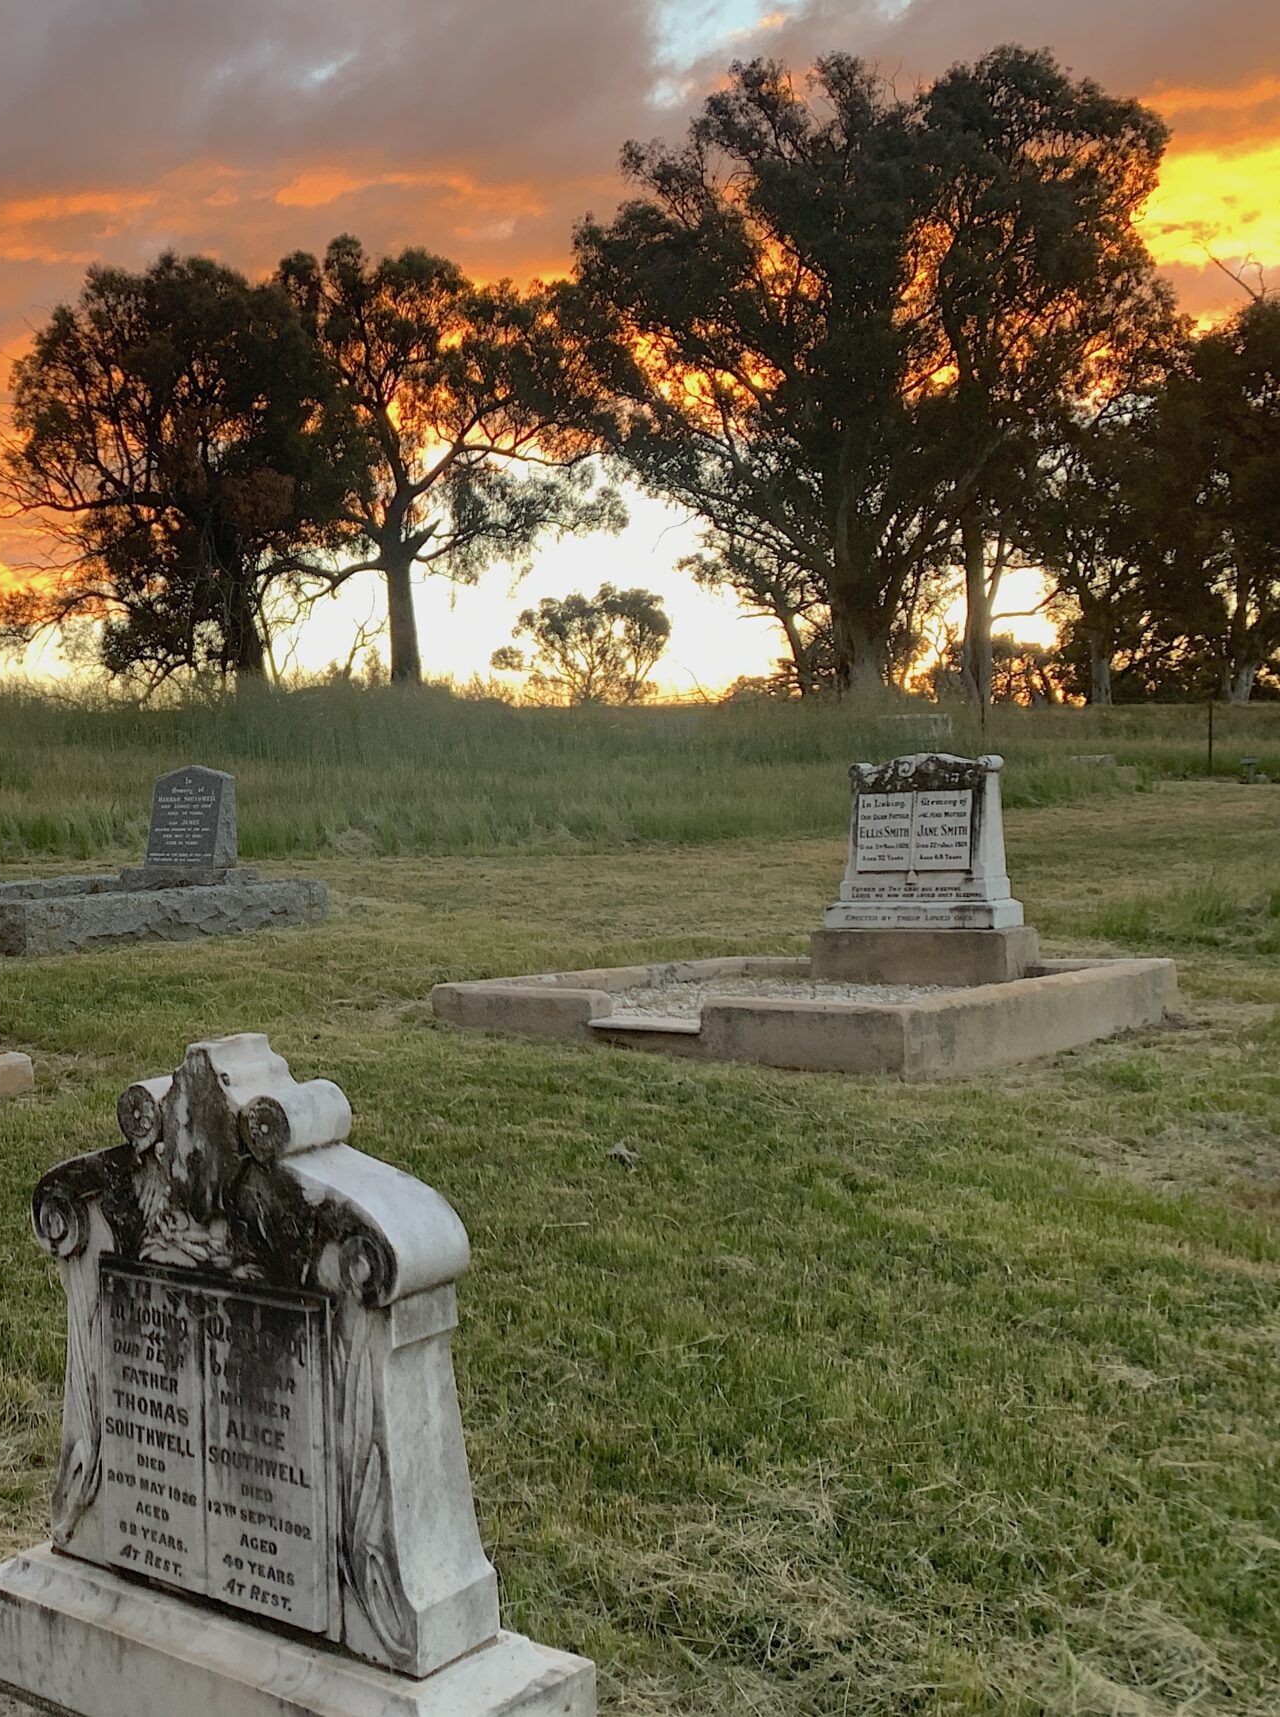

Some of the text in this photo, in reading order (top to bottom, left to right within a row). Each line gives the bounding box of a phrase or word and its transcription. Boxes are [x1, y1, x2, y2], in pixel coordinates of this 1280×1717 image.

[122, 1365, 178, 1395] FATHER
[112, 1388, 189, 1427] THOMAS
[105, 1416, 195, 1459] SOUTHWELL
[226, 1419, 286, 1452] ALICE
[137, 1452, 167, 1474] DIED
[207, 1444, 312, 1490] SOUTHWELL
[139, 1477, 167, 1497] MAY
[241, 1482, 274, 1504] DIED
[135, 1500, 170, 1522] AGED
[239, 1533, 278, 1556] AGED
[248, 1560, 296, 1587] YEARS
